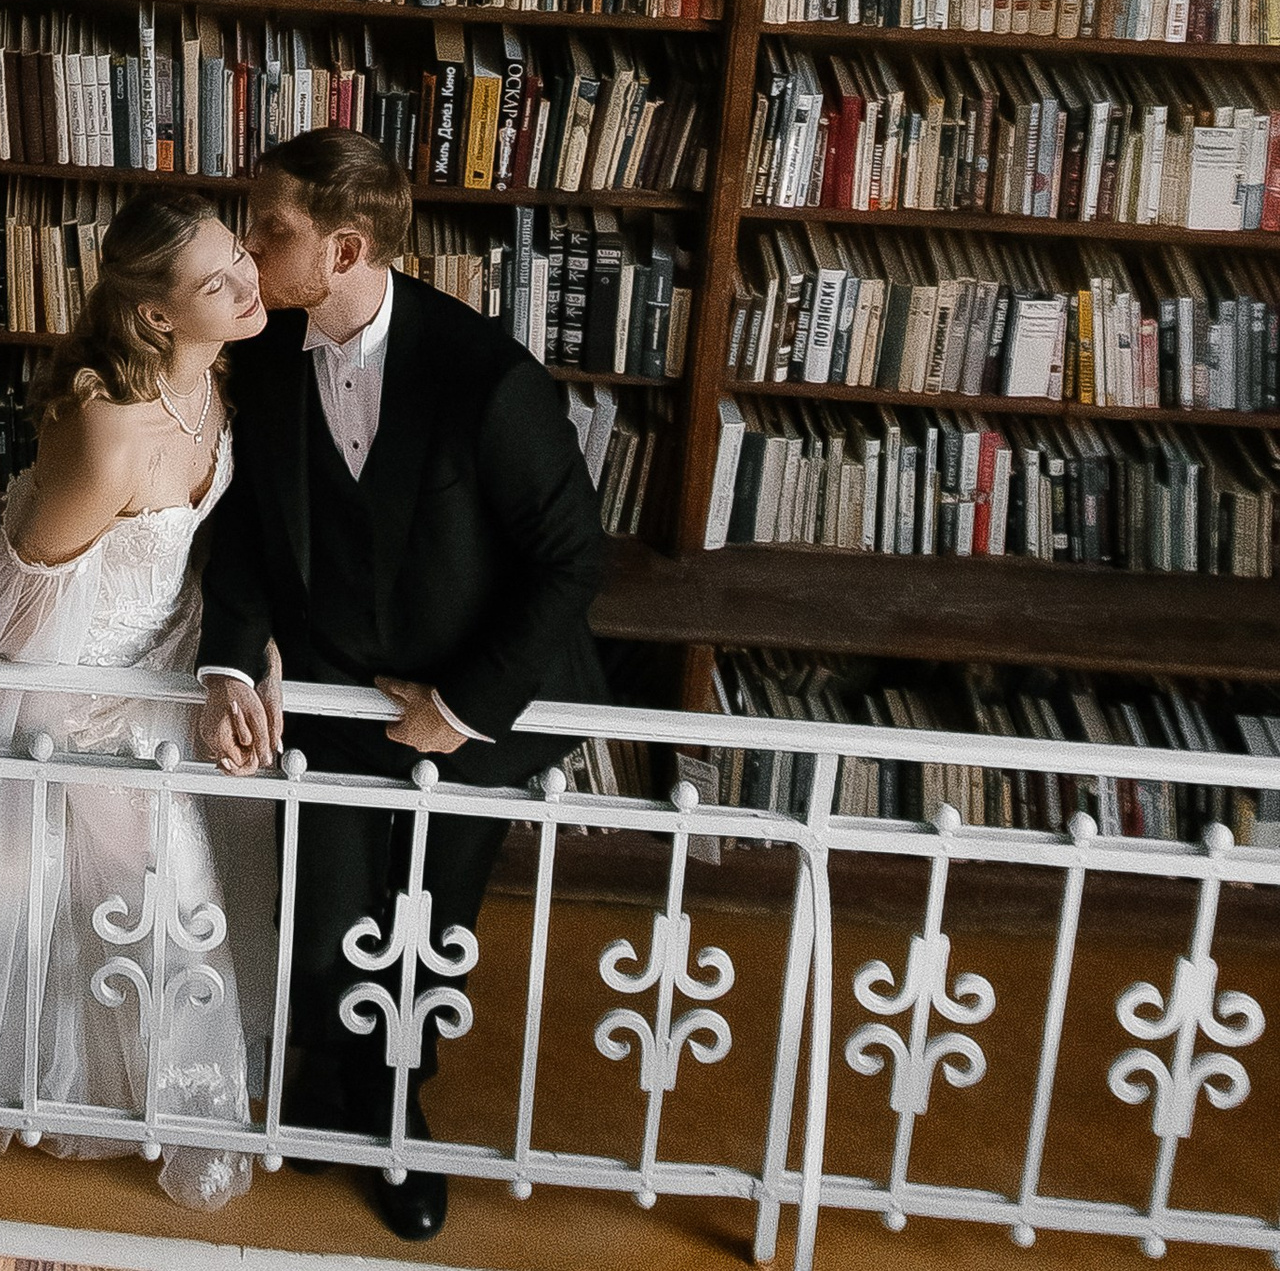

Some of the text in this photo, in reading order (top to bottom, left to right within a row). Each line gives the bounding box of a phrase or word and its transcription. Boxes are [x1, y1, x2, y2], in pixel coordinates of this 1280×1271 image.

[441, 66, 457, 97] Кино
[502, 63, 525, 118] ОСКАР
[434, 140, 451, 174] Жиль
